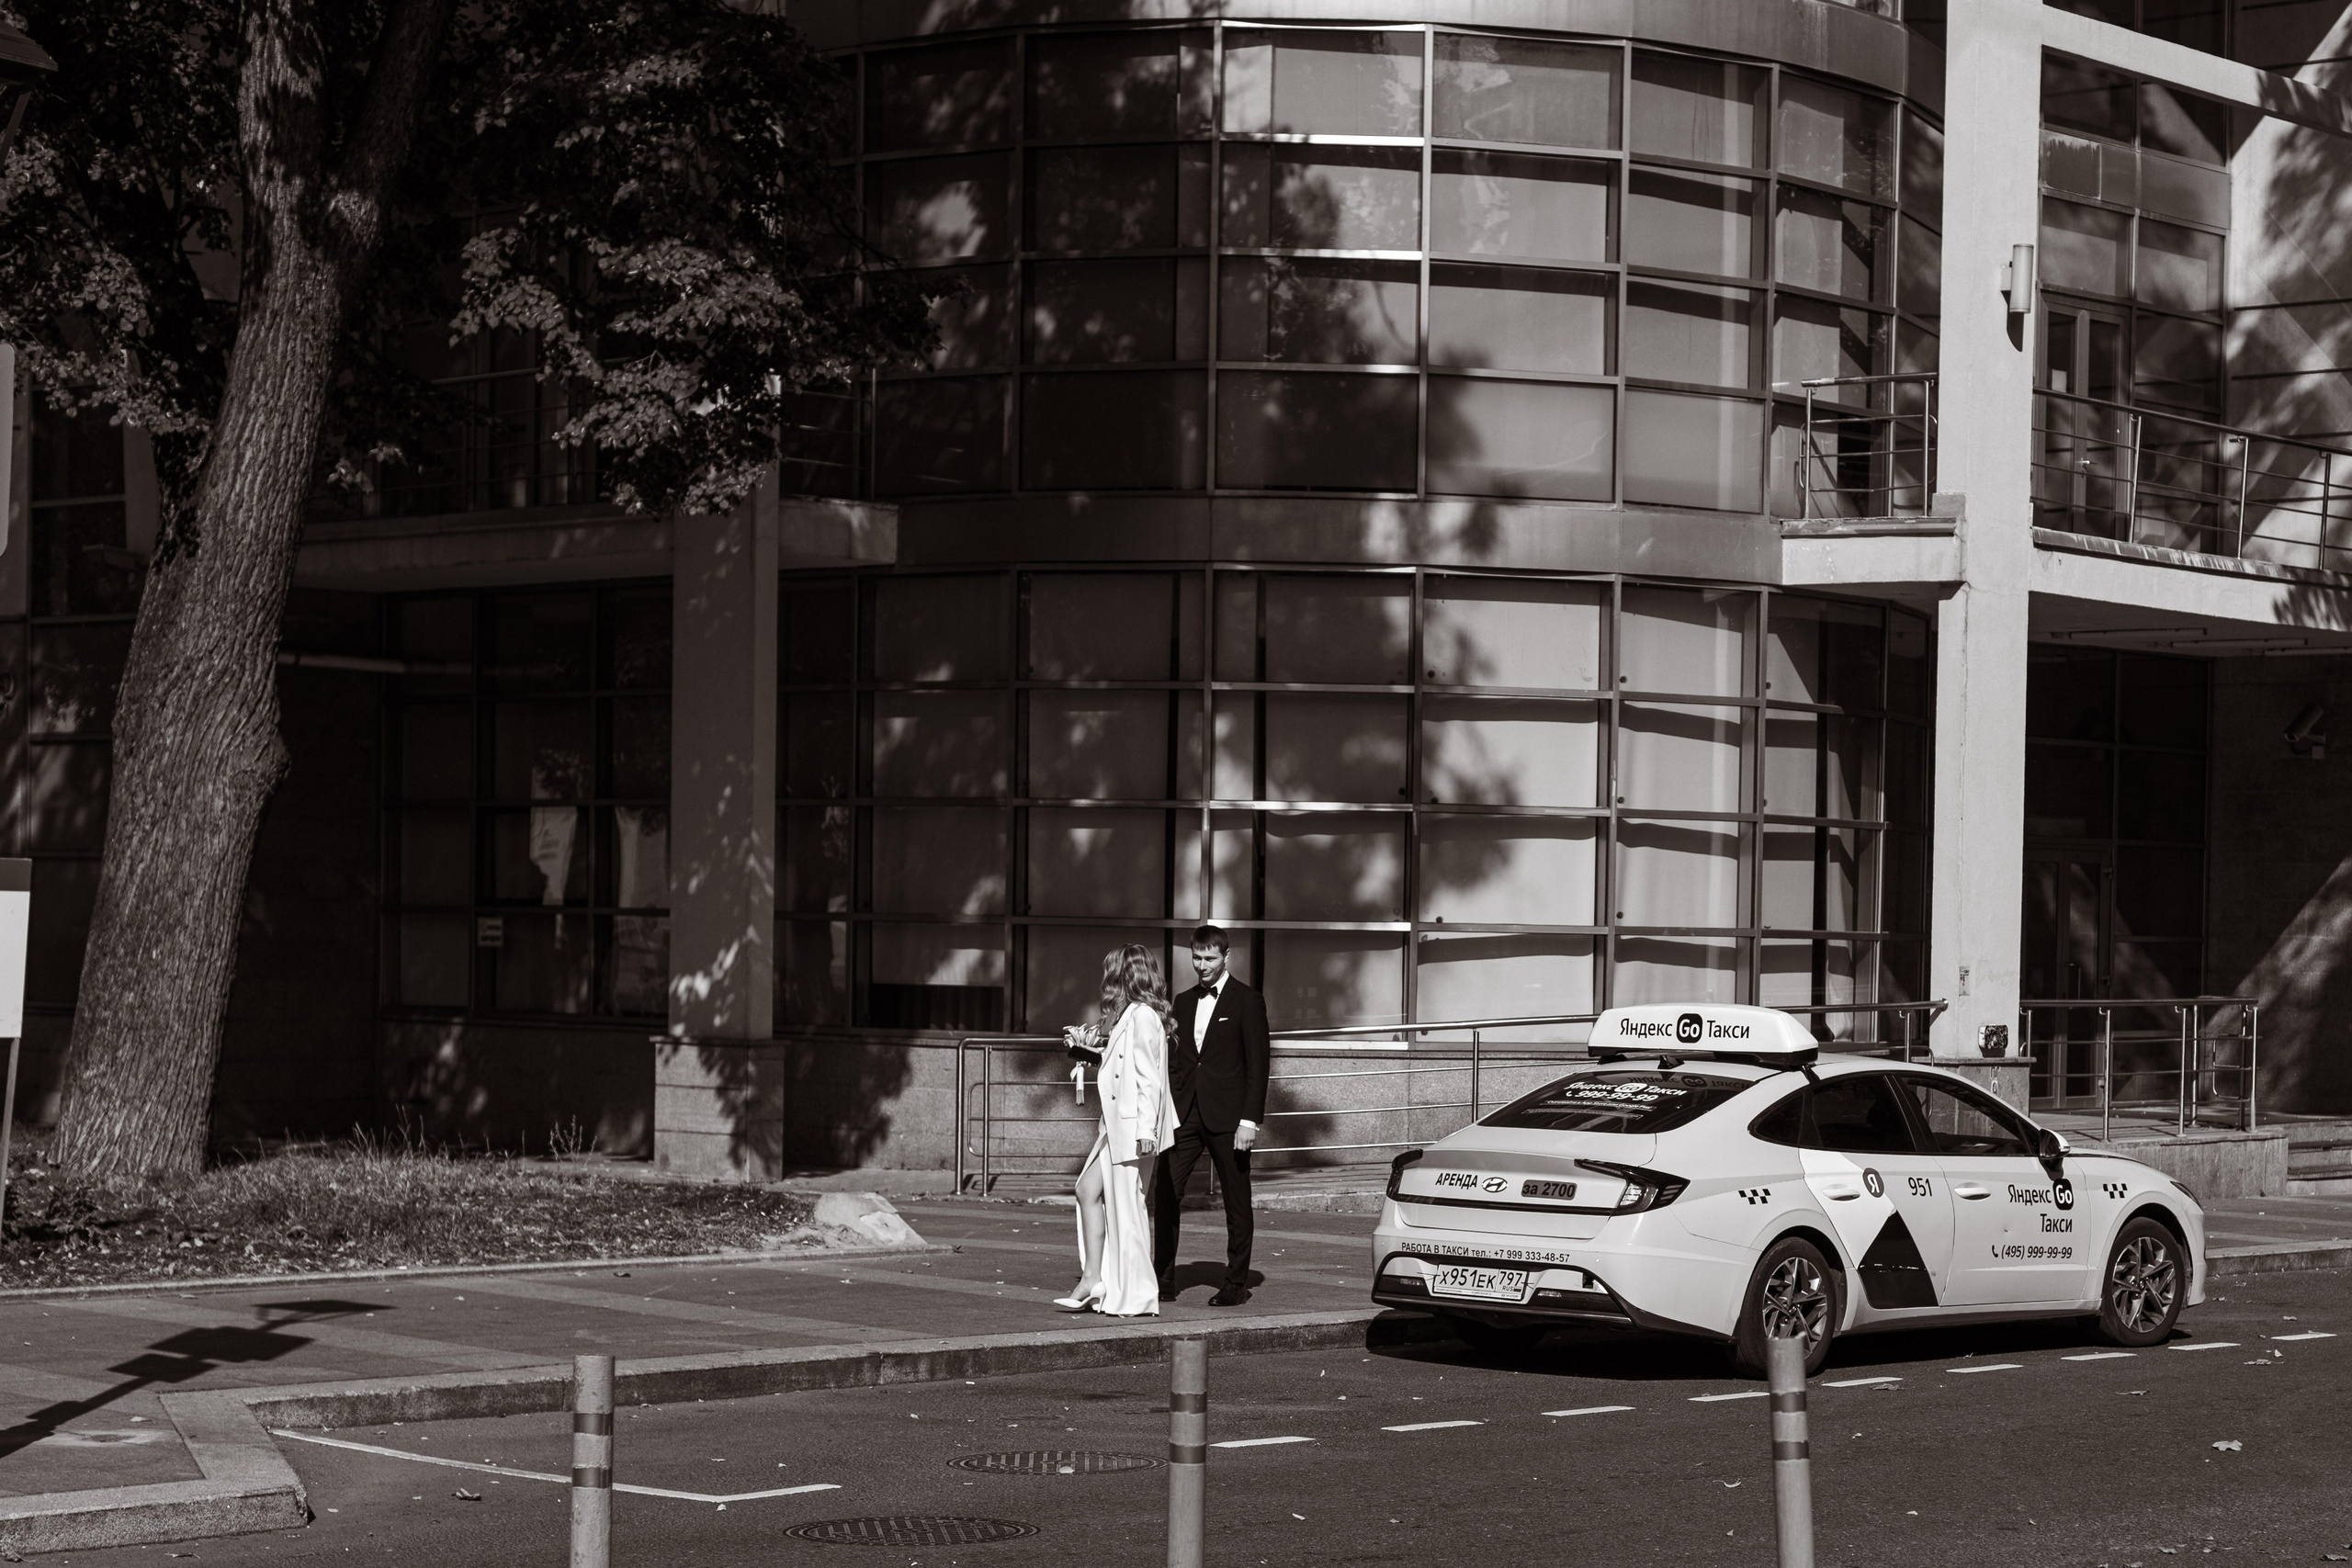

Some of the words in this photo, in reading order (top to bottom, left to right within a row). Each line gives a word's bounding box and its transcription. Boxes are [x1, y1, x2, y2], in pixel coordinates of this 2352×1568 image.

[1620, 1018, 1673, 1039] Яндекс
[1679, 1018, 1700, 1038] Go
[1706, 1020, 1750, 1039] Такси
[1564, 1081, 1615, 1091] Яндекс
[1643, 1084, 1688, 1097] Такси
[1575, 1090, 1659, 1102] 999-99-99
[1435, 1172, 1478, 1190] АРЕНДА
[1522, 1184, 1538, 1195] за
[1542, 1182, 1576, 1198] 2700
[1867, 1173, 1880, 1193] Я
[1908, 1177, 1932, 1197] 951
[2007, 1184, 2052, 1206] Яндекс
[2055, 1184, 2073, 1204] Go
[2040, 1213, 2073, 1233] Такси
[1401, 1242, 1431, 1254] РАБОТА
[1433, 1244, 1440, 1254] В
[1442, 1245, 1469, 1257] ТАКСИ
[1471, 1249, 1491, 1258] тел.:
[1494, 1249, 1504, 1258] +7
[1507, 1249, 1522, 1259] 999
[1525, 1251, 1570, 1263] 333-48-57
[2001, 1245, 2025, 1259] (495)
[2027, 1246, 2073, 1259] 999-99-99
[1498, 1270, 1522, 1286] 797
